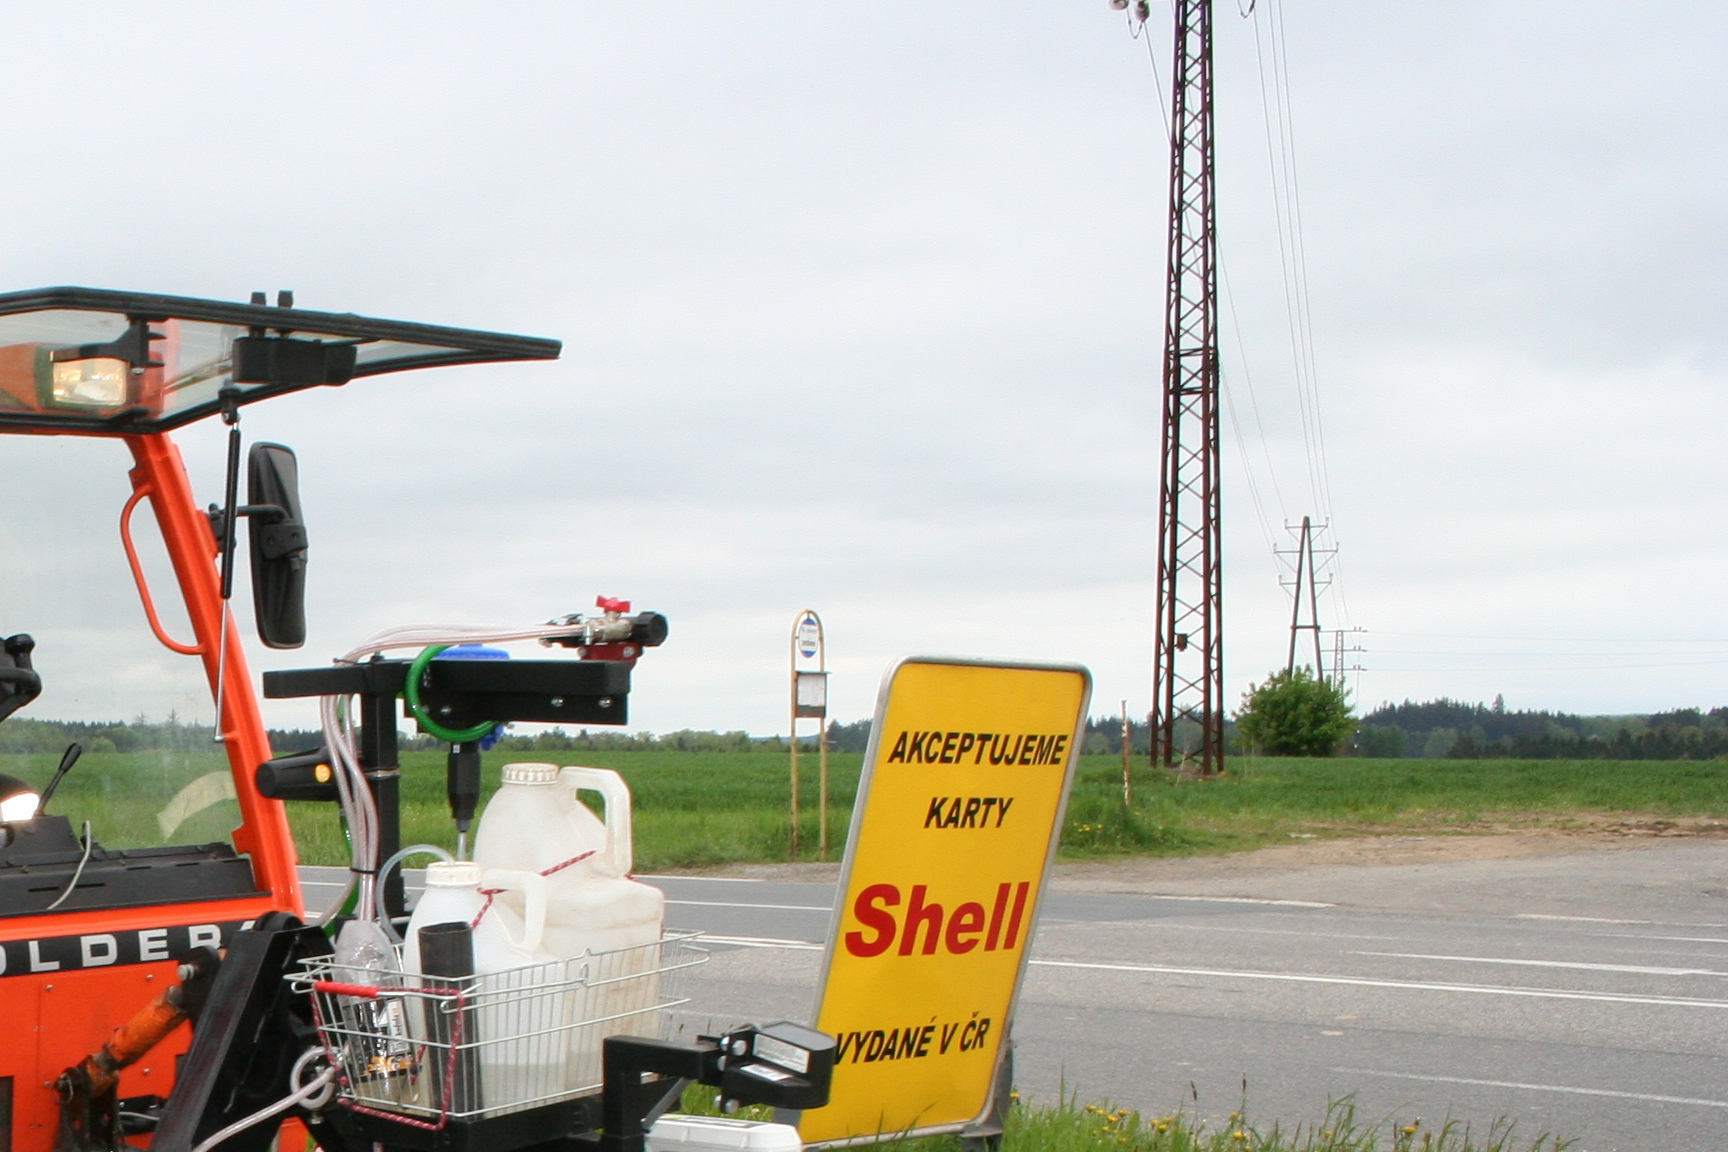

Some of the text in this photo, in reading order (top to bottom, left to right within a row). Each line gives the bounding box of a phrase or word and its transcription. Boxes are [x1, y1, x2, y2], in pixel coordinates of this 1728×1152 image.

[887, 731, 1069, 766] AKCEPTUJEME
[923, 796, 1015, 829] KARTY
[845, 881, 1031, 958] Shell
[833, 1015, 938, 1066] VYDANÉ
[939, 1022, 960, 1055] V
[959, 1010, 991, 1053] ČR
